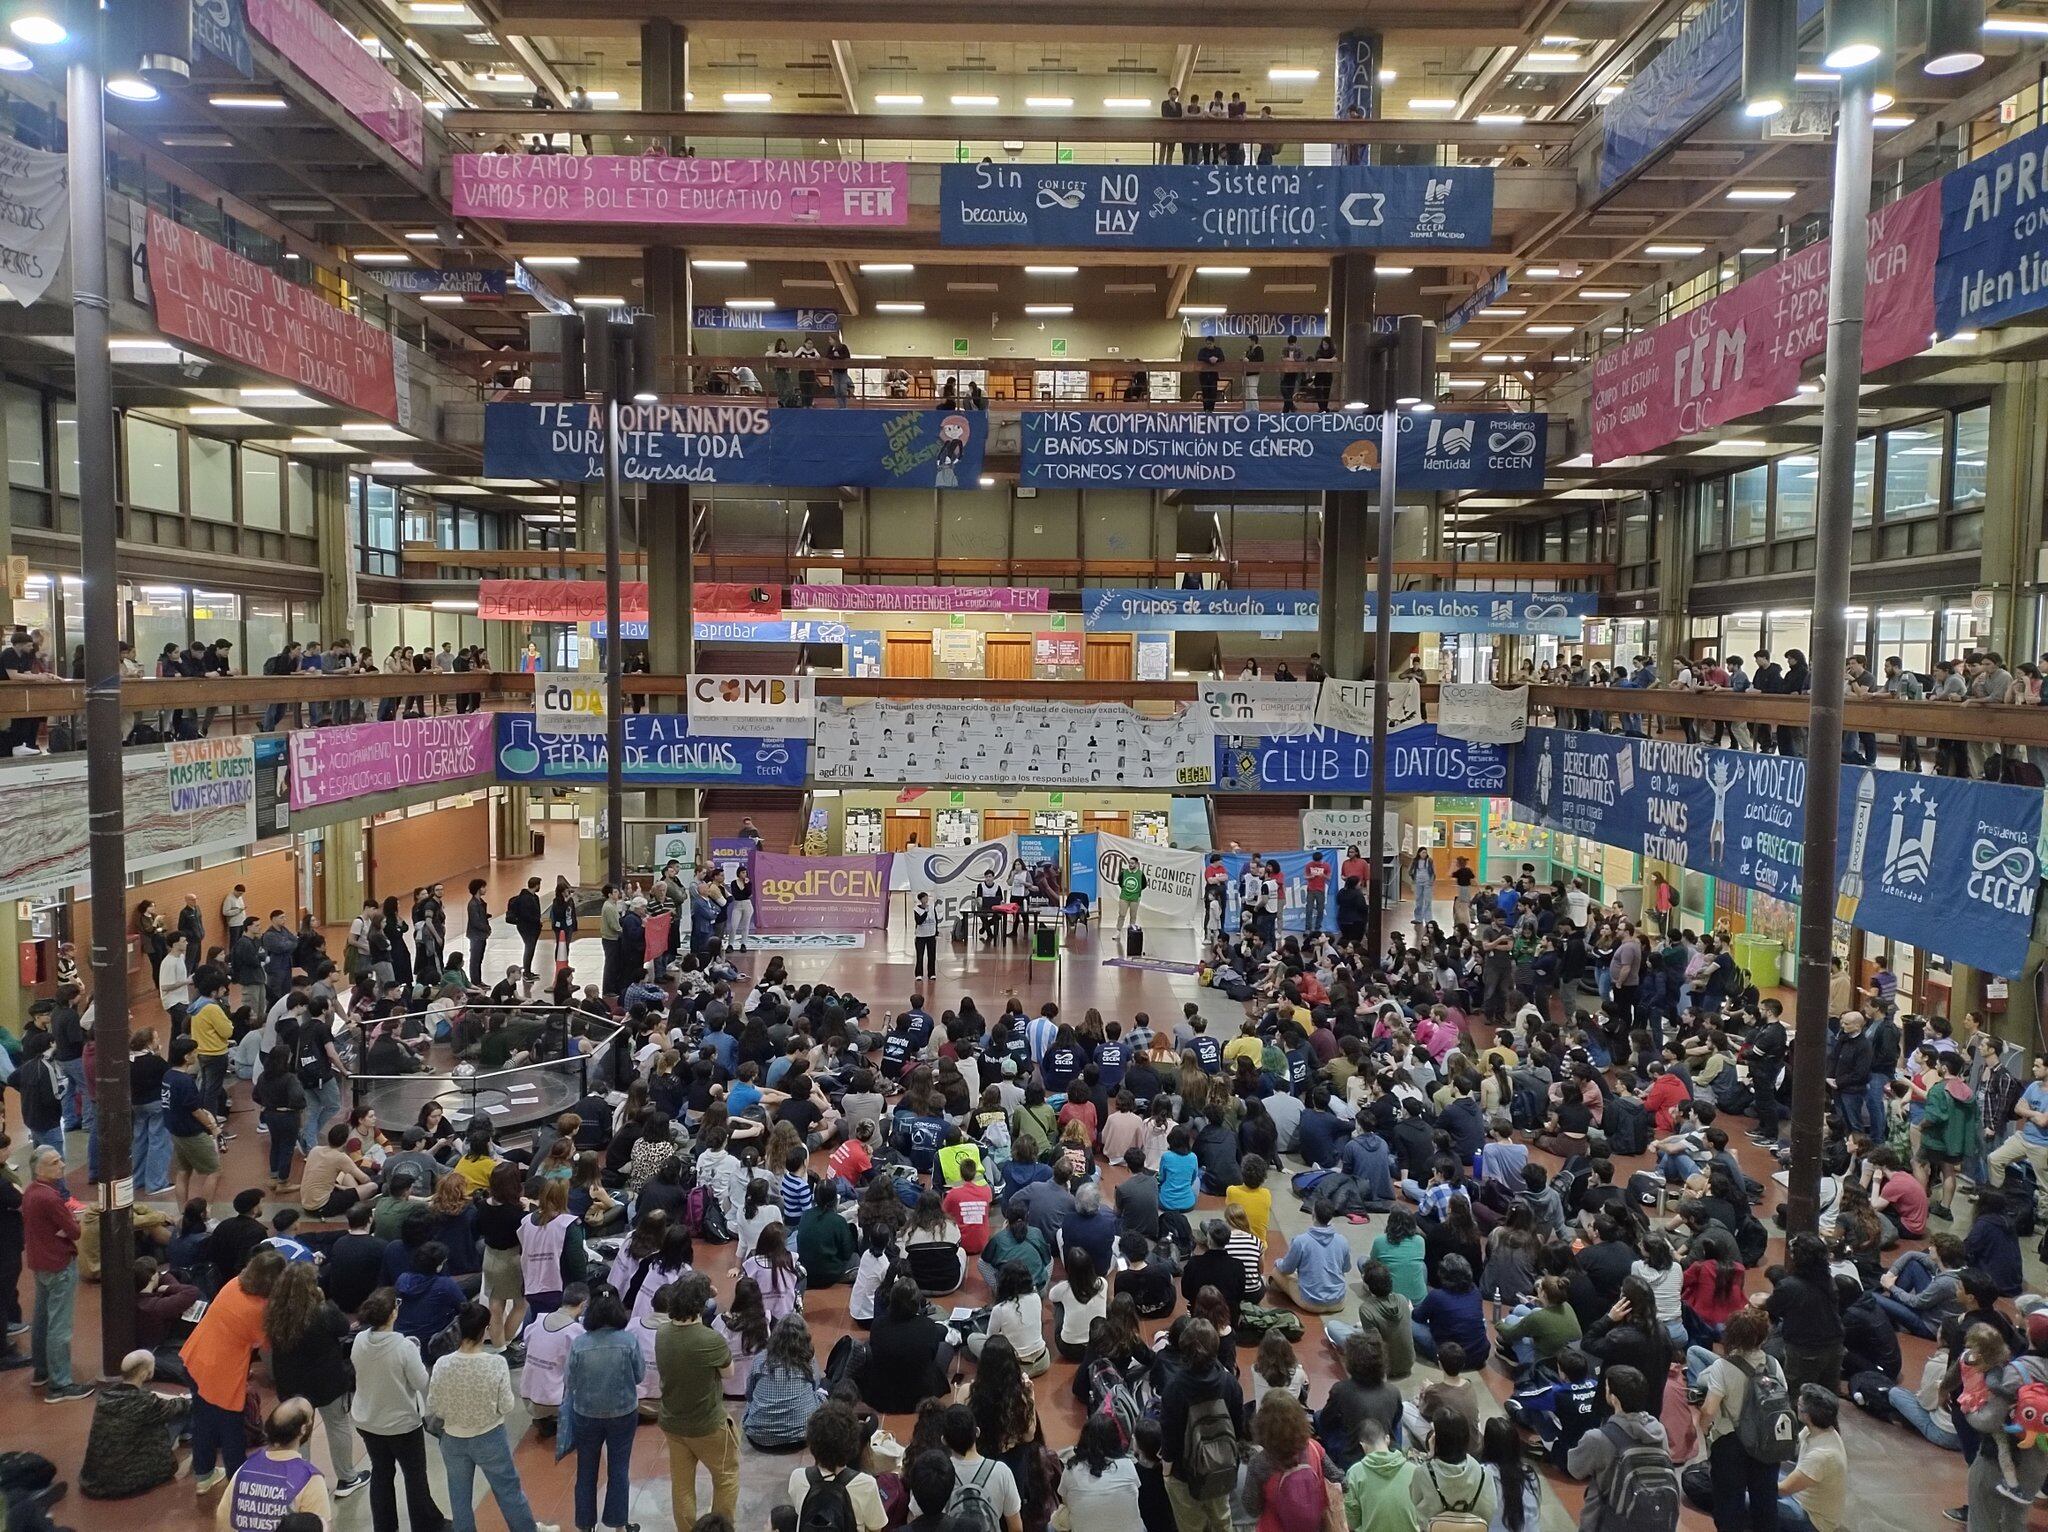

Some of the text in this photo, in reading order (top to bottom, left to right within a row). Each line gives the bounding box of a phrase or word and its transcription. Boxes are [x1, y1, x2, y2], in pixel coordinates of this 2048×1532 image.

[461, 156, 593, 180] LOGRAMOS
[711, 160, 736, 183] DE
[749, 160, 892, 185] TRANSPORTE
[976, 162, 1022, 189] Sin
[1207, 170, 1300, 195] Sistema
[462, 183, 525, 208] VAMOS
[533, 185, 569, 208] POR
[584, 187, 667, 208] BOLETO
[1038, 180, 1087, 191] CONICET
[1101, 174, 1139, 202] NO
[961, 201, 1028, 224] becarixs
[1096, 210, 1140, 233] HAY
[152, 213, 182, 257] POR
[193, 234, 215, 273] UN
[225, 251, 264, 296] CECEN
[272, 275, 294, 312] QUE
[299, 288, 352, 340] ENFRENTE
[164, 256, 377, 380] EL AJUSTE DE MILEI Y EL FMI
[697, 309, 766, 328] PRE-PARCIAL
[1215, 315, 1317, 335] RECORRIDAS POR
[1690, 301, 1718, 339] CBC
[184, 304, 287, 373] EN CIENCIA Y
[1674, 317, 1747, 407] FEM
[530, 402, 770, 434] TE AOMPAÑAMOS
[1490, 420, 1536, 431] Presidencia
[676, 433, 744, 459] TODA
[1045, 435, 1102, 456] BAÑOS
[1223, 441, 1243, 457] DE
[1250, 436, 1314, 458] GÉNERO
[624, 457, 717, 482] Cursada
[1043, 463, 1121, 480] TORNEOS
[1125, 463, 1136, 480] Y
[1424, 458, 1471, 470] Identidad
[1488, 457, 1533, 469] CECEN
[483, 595, 607, 617] DEFENDAMOS
[793, 588, 951, 611] SALARIOS DIGNOS PARA DEFENDER
[1010, 588, 1039, 608] FEM
[1121, 598, 1177, 621] grupos
[1182, 596, 1201, 614] de
[1208, 595, 1264, 616] estudio
[1276, 601, 1285, 615] y
[1412, 598, 1479, 617] los labos
[1532, 594, 1573, 603] Presidencia
[700, 623, 758, 640] aprobar
[875, 703, 924, 711] Estudiantes
[926, 703, 988, 712] desaparecidos
[990, 704, 1000, 712] de
[1049, 705, 1059, 713] de
[1061, 706, 1095, 714] ciencias
[393, 719, 470, 748] LO PEDIMOS
[172, 740, 242, 764] EXIGIMOS
[395, 745, 476, 783] LO LOGRAMOS
[542, 743, 736, 770] FERIA DE CIENCIAS
[1262, 747, 1466, 781] CLUB DATOS
[1640, 741, 1702, 778] REFORMAS
[756, 766, 782, 775] CECEN
[819, 765, 854, 777] agdFCEN
[1177, 767, 1211, 784] CECEN
[1564, 752, 1609, 780] DERECHOS
[171, 779, 252, 811] UNIVERSITARIO
[1468, 779, 1503, 788] CECEN
[1563, 775, 1615, 806] ESTUDIANTILES
[1651, 775, 1679, 796] en los
[1747, 759, 1805, 807] MODELO
[1647, 797, 1688, 833] PLANES
[1851, 805, 1868, 870] TRONADOR
[1977, 820, 2029, 844] Presidencia
[762, 869, 882, 904] agdFCEN
[1155, 866, 1197, 886] CONICET
[1740, 859, 1750, 876] de
[1780, 881, 1788, 894] y
[1175, 883, 1193, 898] UBA
[1967, 874, 2035, 916] CECEN
